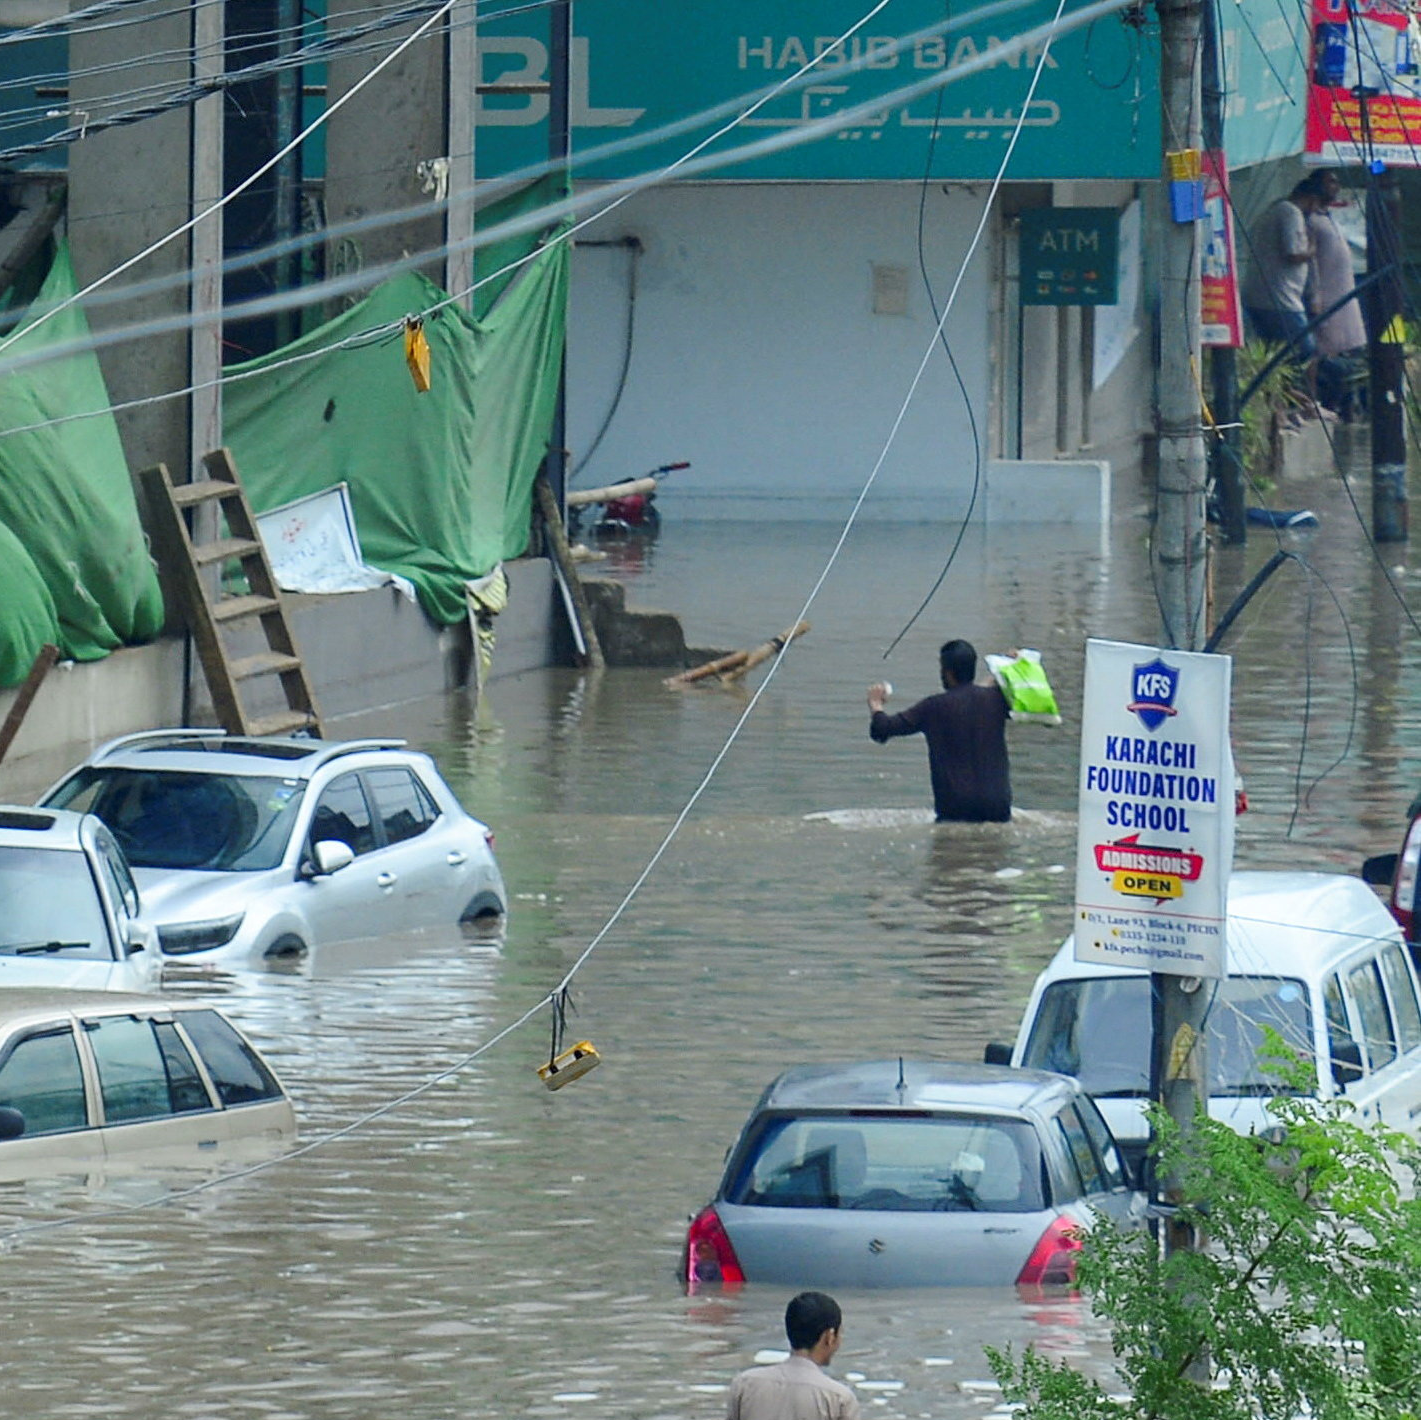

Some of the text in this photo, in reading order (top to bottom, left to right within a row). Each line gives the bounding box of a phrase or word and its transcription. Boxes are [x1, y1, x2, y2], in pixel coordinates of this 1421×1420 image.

[737, 35, 1059, 70] HABIB BANK
[1039, 228, 1099, 252] ATM
[1137, 672, 1172, 699] KFS
[1105, 735, 1196, 768] KARACHI
[1087, 767, 1216, 803] FOUNDATION
[1106, 801, 1190, 832] SCHOOL
[1101, 847, 1193, 875] ADMISSIONS
[1122, 876, 1172, 893] OPEN
[1107, 913, 1130, 926] Lane
